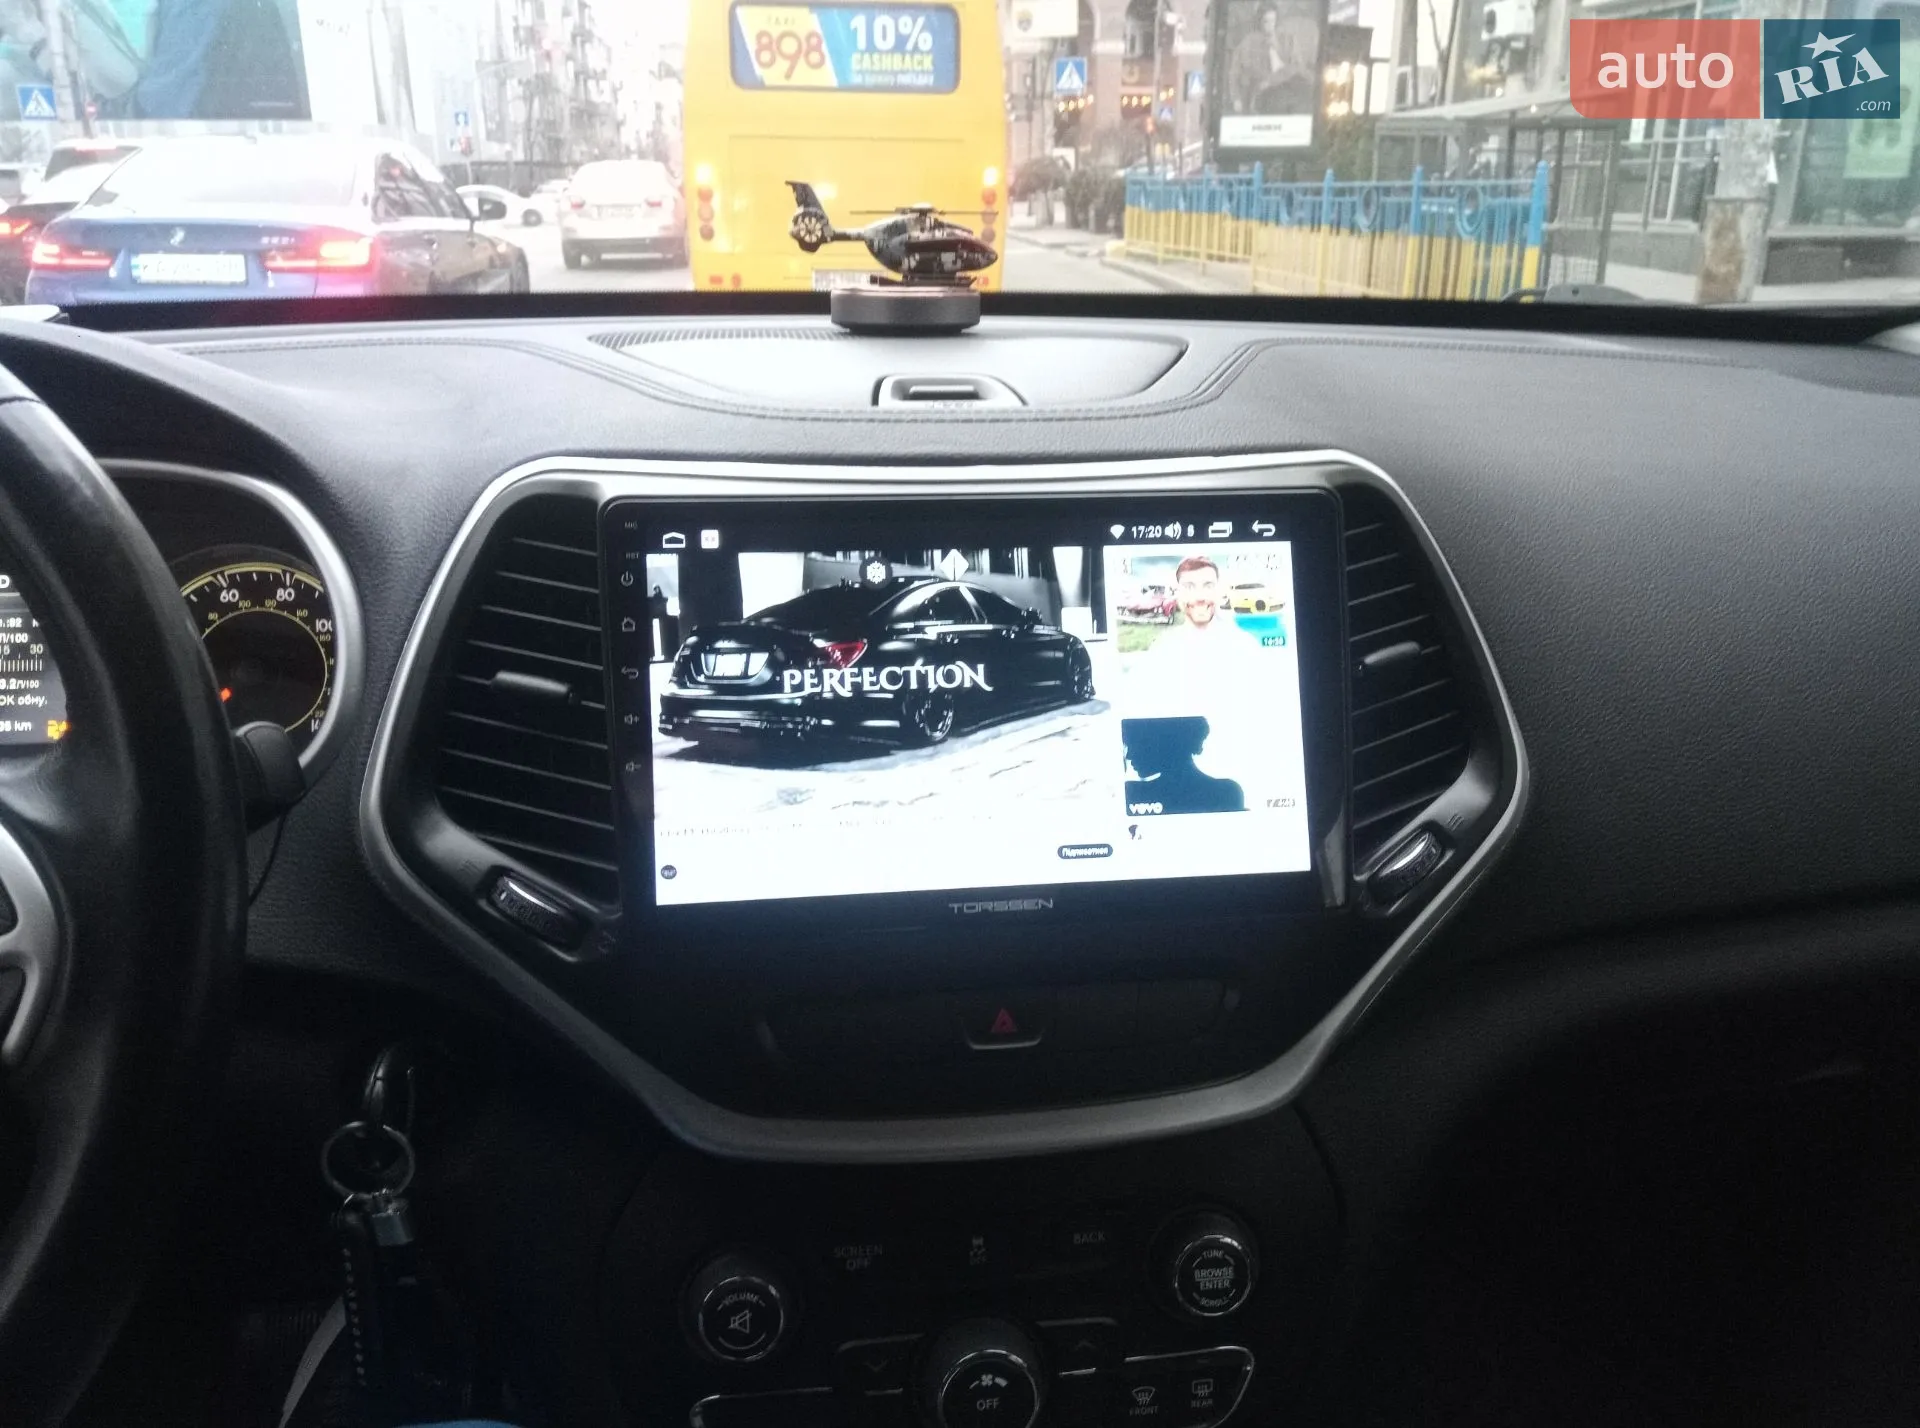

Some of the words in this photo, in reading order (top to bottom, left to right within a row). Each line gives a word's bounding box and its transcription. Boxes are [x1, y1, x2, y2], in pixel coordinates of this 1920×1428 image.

[850, 14, 933, 51] 10%
[755, 30, 826, 81] 898
[851, 52, 935, 72] CASHBACK
[1131, 525, 1163, 539] 17:20
[219, 589, 240, 603] 60
[276, 587, 296, 602] 80
[30, 643, 44, 655] 30
[782, 656, 994, 698] PERFECTION
[14, 719, 32, 732] km
[948, 898, 1054, 915] TORSSEN
[1073, 1231, 1106, 1245] BACK
[834, 1243, 883, 1258] SCREEN
[1202, 1249, 1225, 1259] TUNE
[846, 1258, 871, 1271] OFF
[1194, 1266, 1234, 1279] BROWSE
[1200, 1279, 1231, 1291] ENTER
[976, 1397, 1001, 1412] OFF
[1129, 1404, 1159, 1417] FRONT
